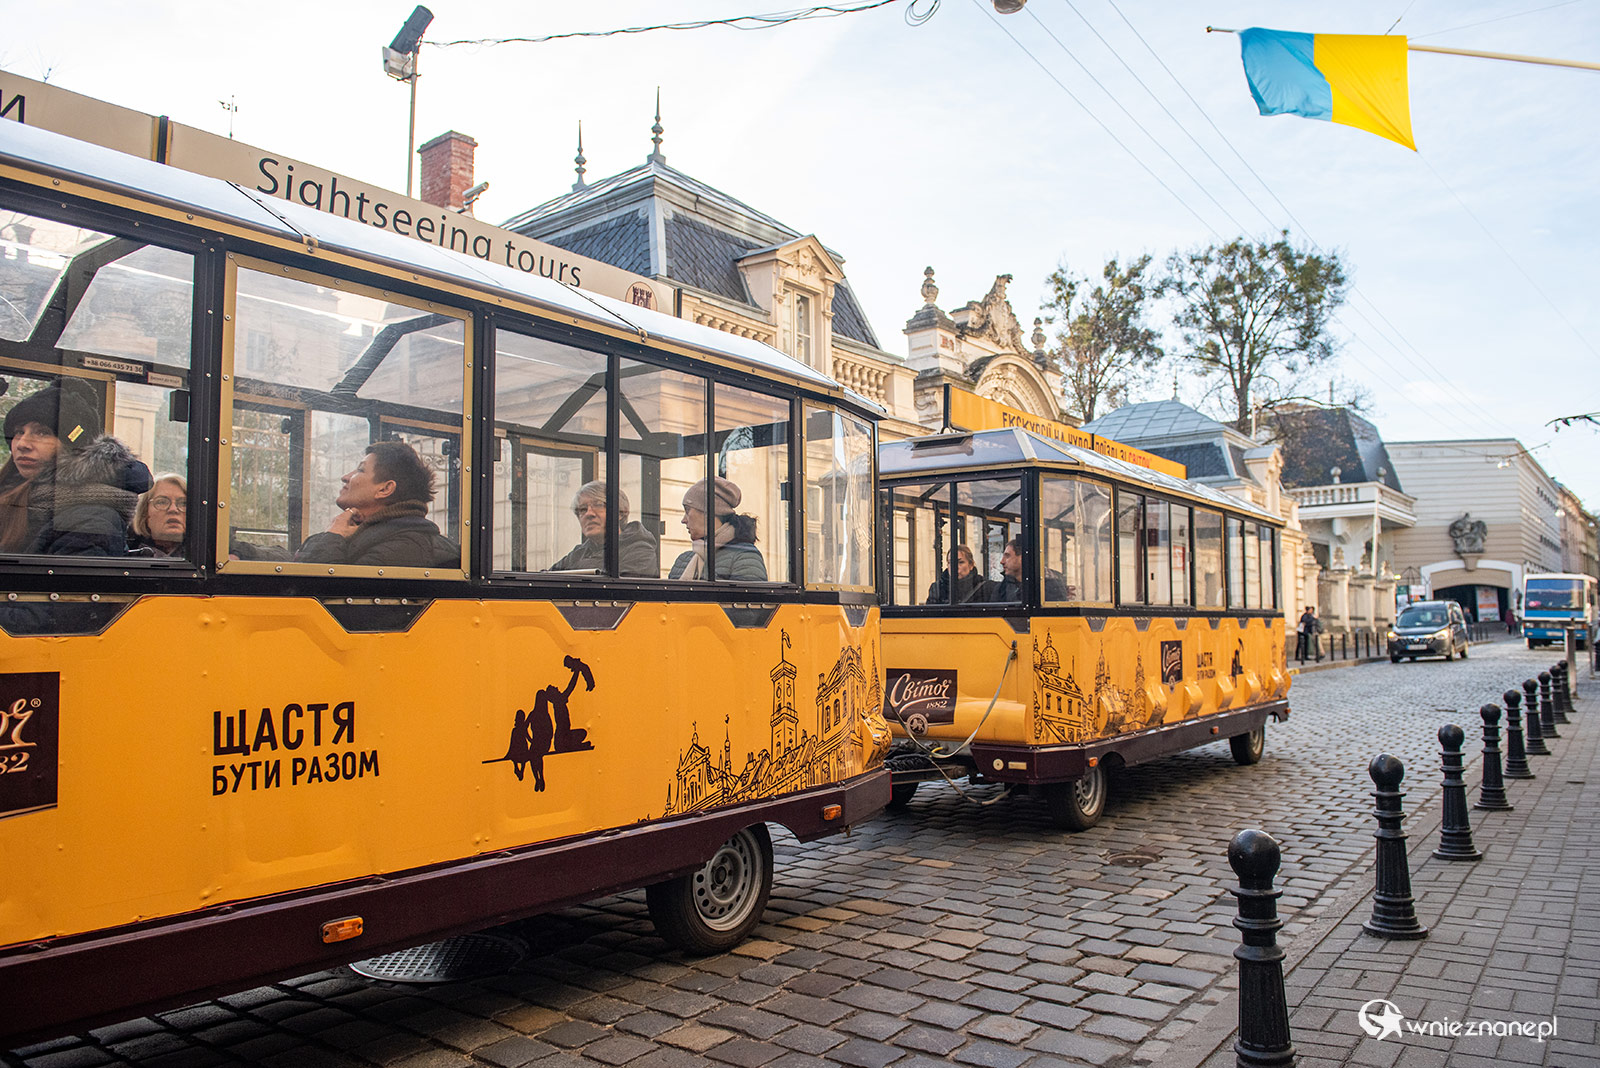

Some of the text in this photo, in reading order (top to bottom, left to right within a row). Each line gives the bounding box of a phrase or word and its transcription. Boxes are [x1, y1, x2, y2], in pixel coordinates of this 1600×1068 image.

[256, 157, 582, 289] Sightseeing tours
[213, 701, 355, 756] ЩАСТЯ
[926, 700, 948, 709] 1882
[212, 750, 380, 796] БУТИ РАЗОМ
